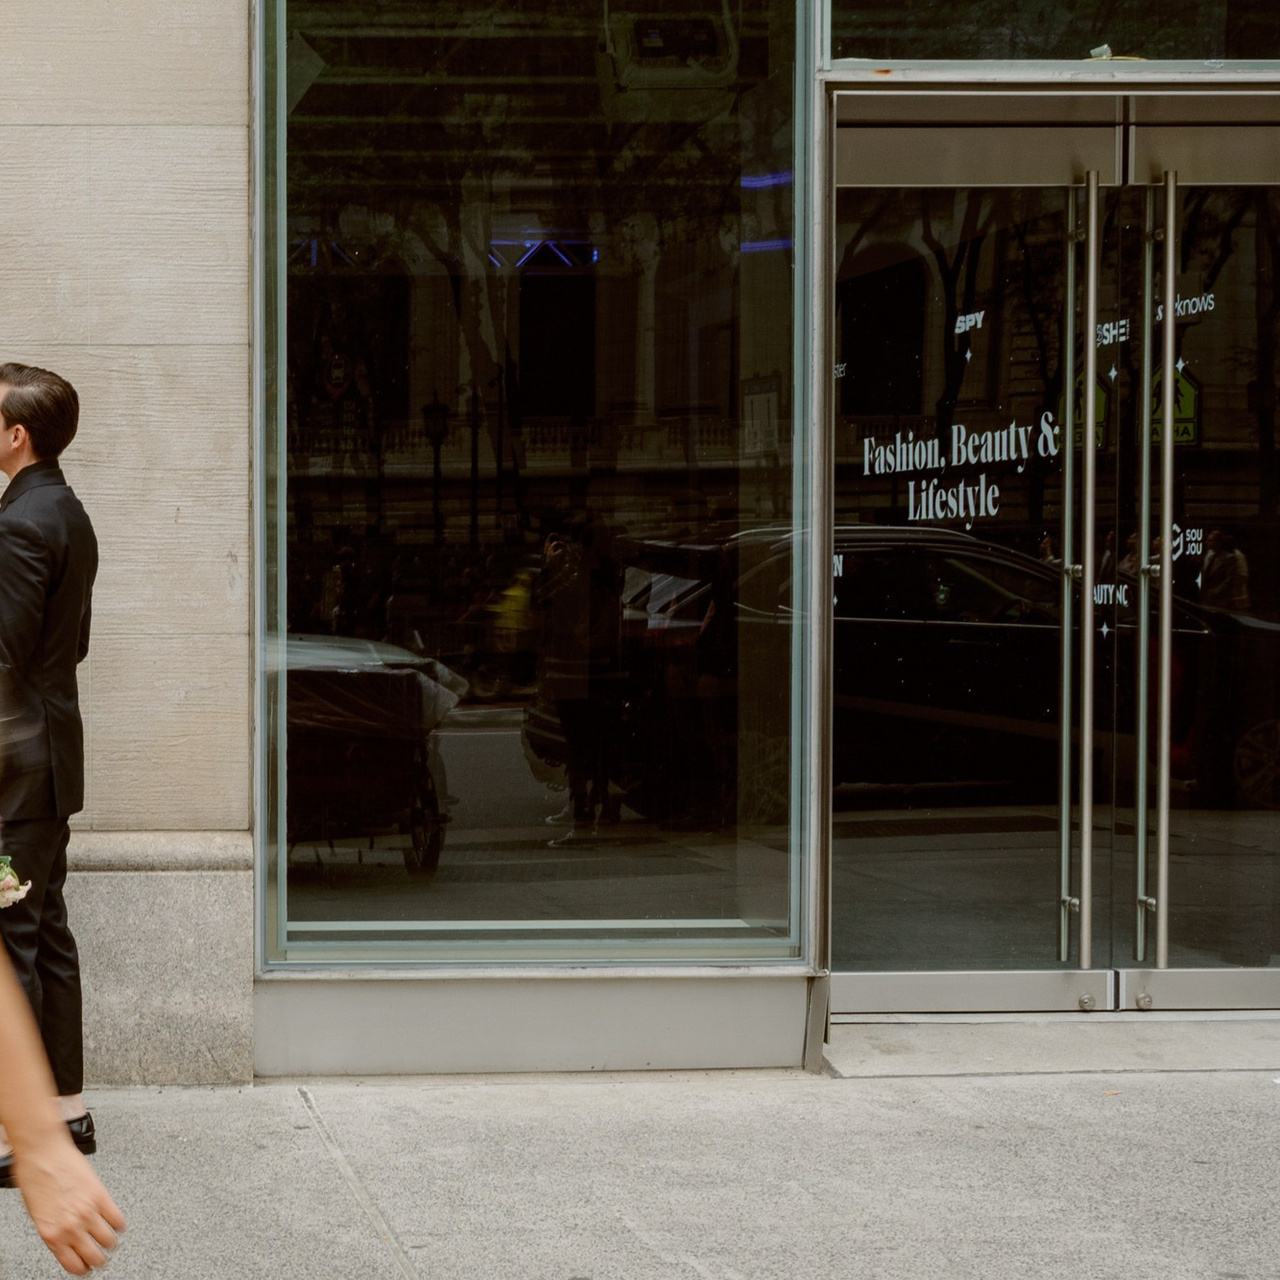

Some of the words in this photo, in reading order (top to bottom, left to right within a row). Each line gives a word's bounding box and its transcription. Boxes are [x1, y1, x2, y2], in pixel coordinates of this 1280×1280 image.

[1156, 293, 1215, 321] sknows
[954, 310, 986, 334] SPY
[863, 431, 946, 475] Fashion,
[951, 418, 1033, 473] Beauty
[1037, 411, 1060, 457] &
[908, 473, 1000, 531] Lifestyle
[1185, 528, 1203, 541] SOU
[1185, 543, 1203, 555] JOU
